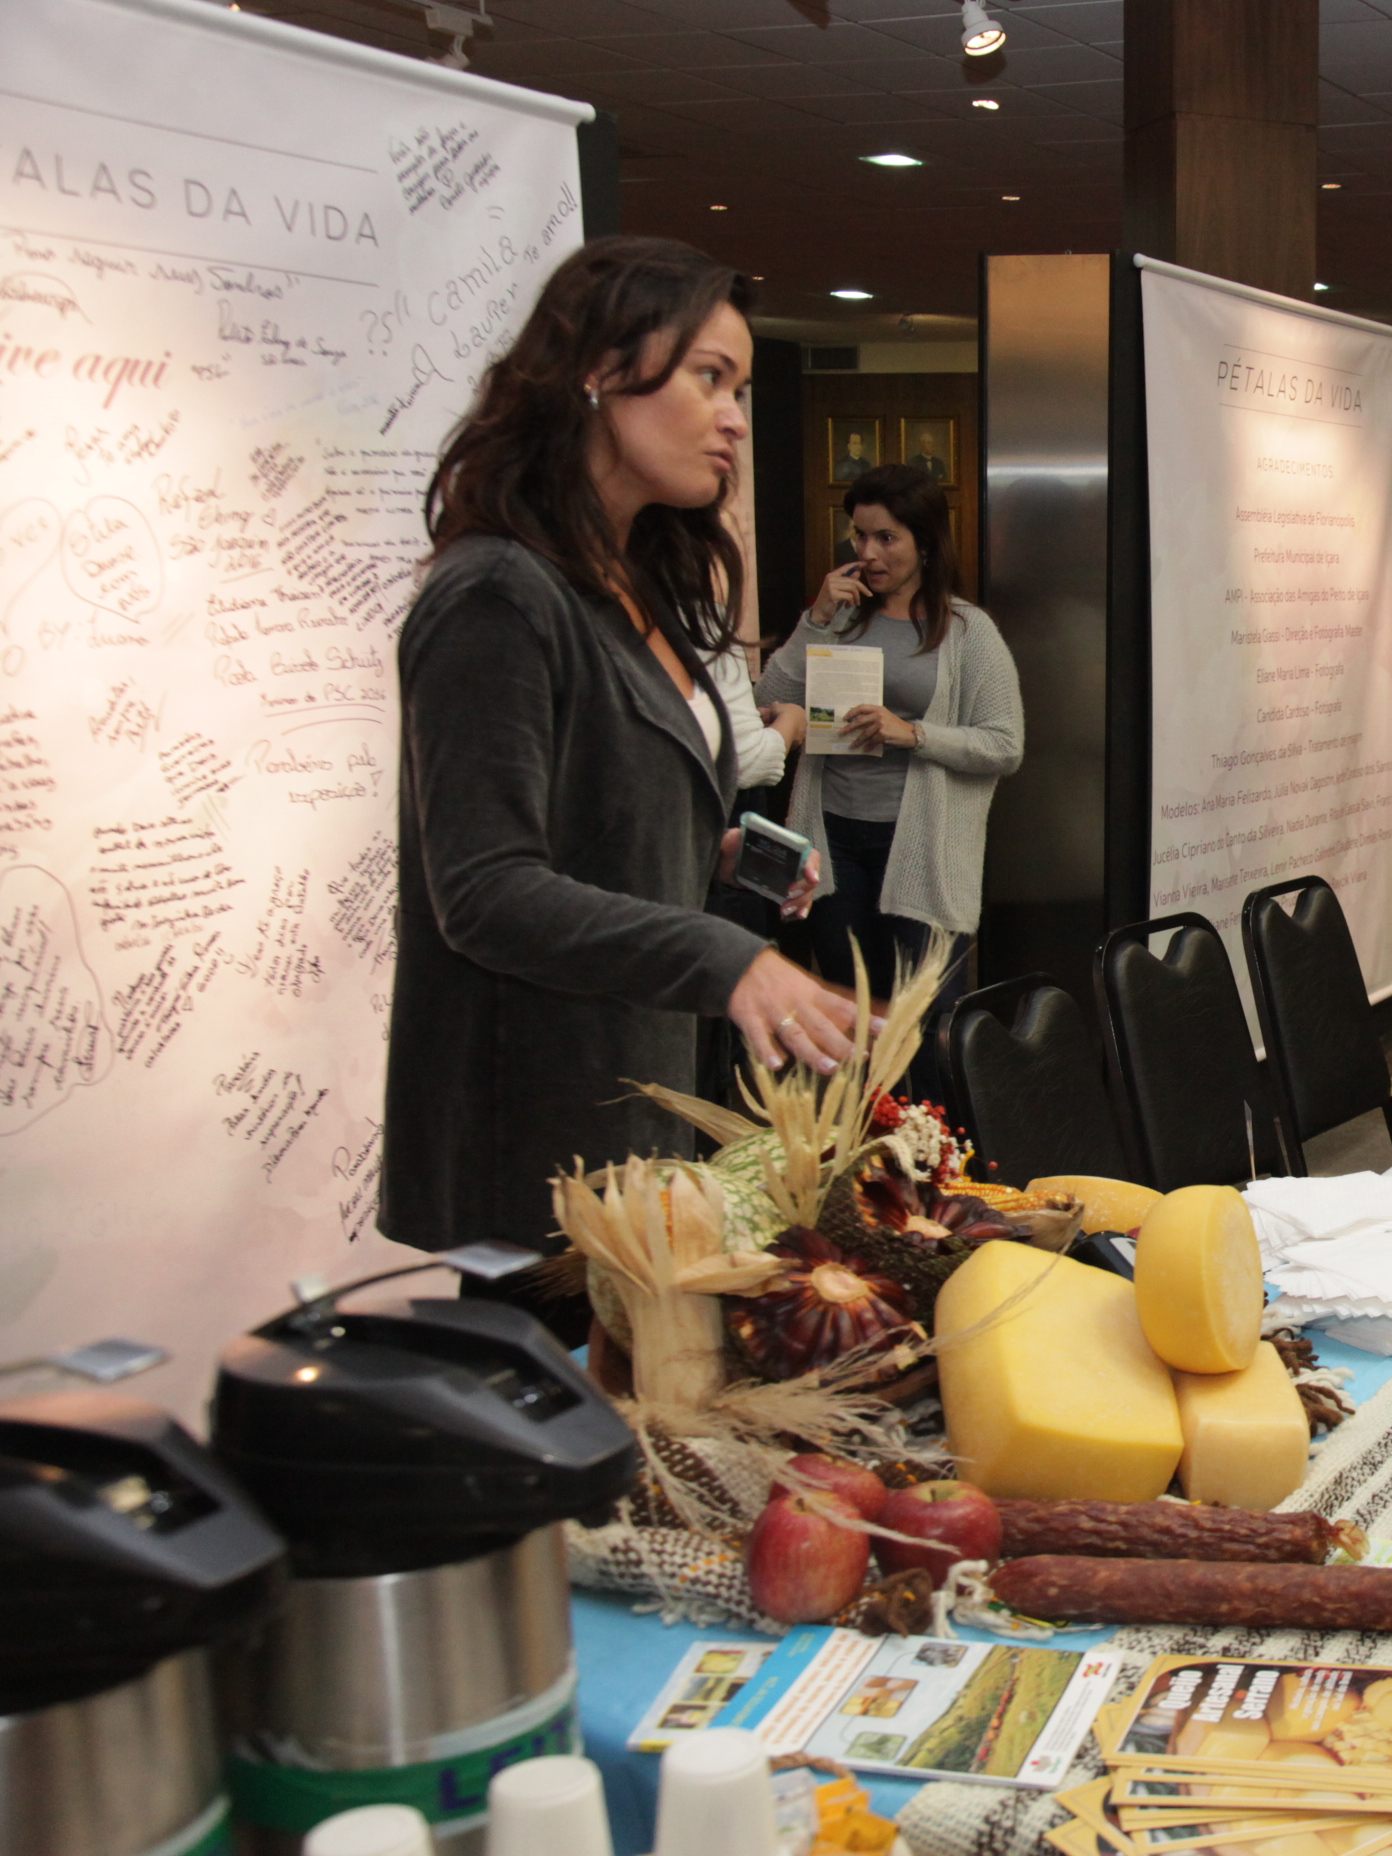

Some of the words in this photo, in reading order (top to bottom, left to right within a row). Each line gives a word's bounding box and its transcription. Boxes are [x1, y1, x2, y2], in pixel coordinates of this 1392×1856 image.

[0, 142, 158, 210] ALAS
[184, 178, 251, 226] DA
[274, 195, 379, 248] VIDA
[72, 351, 172, 409] aqui
[1217, 358, 1298, 401] PÉTALAS
[1304, 379, 1323, 406] DA
[1331, 384, 1362, 413] VIDA
[1257, 457, 1333, 479] AGRADECIMENTOS
[1274, 509, 1306, 527] Legislativa
[1308, 512, 1315, 525] de
[1254, 548, 1285, 563] Prefeitura
[1286, 549, 1315, 566] Municipal
[1316, 551, 1323, 564] de
[1325, 552, 1339, 567] Içara
[1225, 588, 1243, 603] AMPI
[1251, 588, 1283, 606] Associação
[1285, 590, 1296, 603] das
[1298, 588, 1320, 605] Amigas
[1321, 589, 1328, 601] do
[1330, 587, 1346, 601] Peito
[1347, 588, 1355, 601] de
[1231, 629, 1261, 645] Maristela
[1286, 626, 1310, 644] Direção
[1314, 624, 1344, 642] Fotógrafa
[1256, 668, 1276, 683] Eliane
[1276, 667, 1294, 681] Maria
[1295, 666, 1309, 679] Lima
[1315, 662, 1344, 679] Fotógrafa
[1285, 705, 1309, 720] Cardoso
[1211, 754, 1238, 771] Thiago
[1240, 750, 1277, 766] Gonçalves
[1278, 747, 1286, 759] da
[1287, 742, 1303, 757] Silva
[1161, 801, 1200, 820] Modelos:
[1202, 798, 1214, 813] Ana
[1215, 793, 1235, 810] Maria
[1290, 780, 1308, 793] Novak
[1152, 845, 1179, 866] Jucélia
[1182, 840, 1215, 860] Cipriano
[1216, 836, 1224, 850] do
[1247, 829, 1257, 843] da
[1153, 890, 1180, 907] Vianna
[1182, 882, 1209, 899] Vieira,
[1289, 856, 1313, 870] Pacheco
[1158, 1669, 1203, 1710] Queijo
[1191, 1664, 1245, 1723] Artesanal
[1232, 1670, 1280, 1720] Serrano
